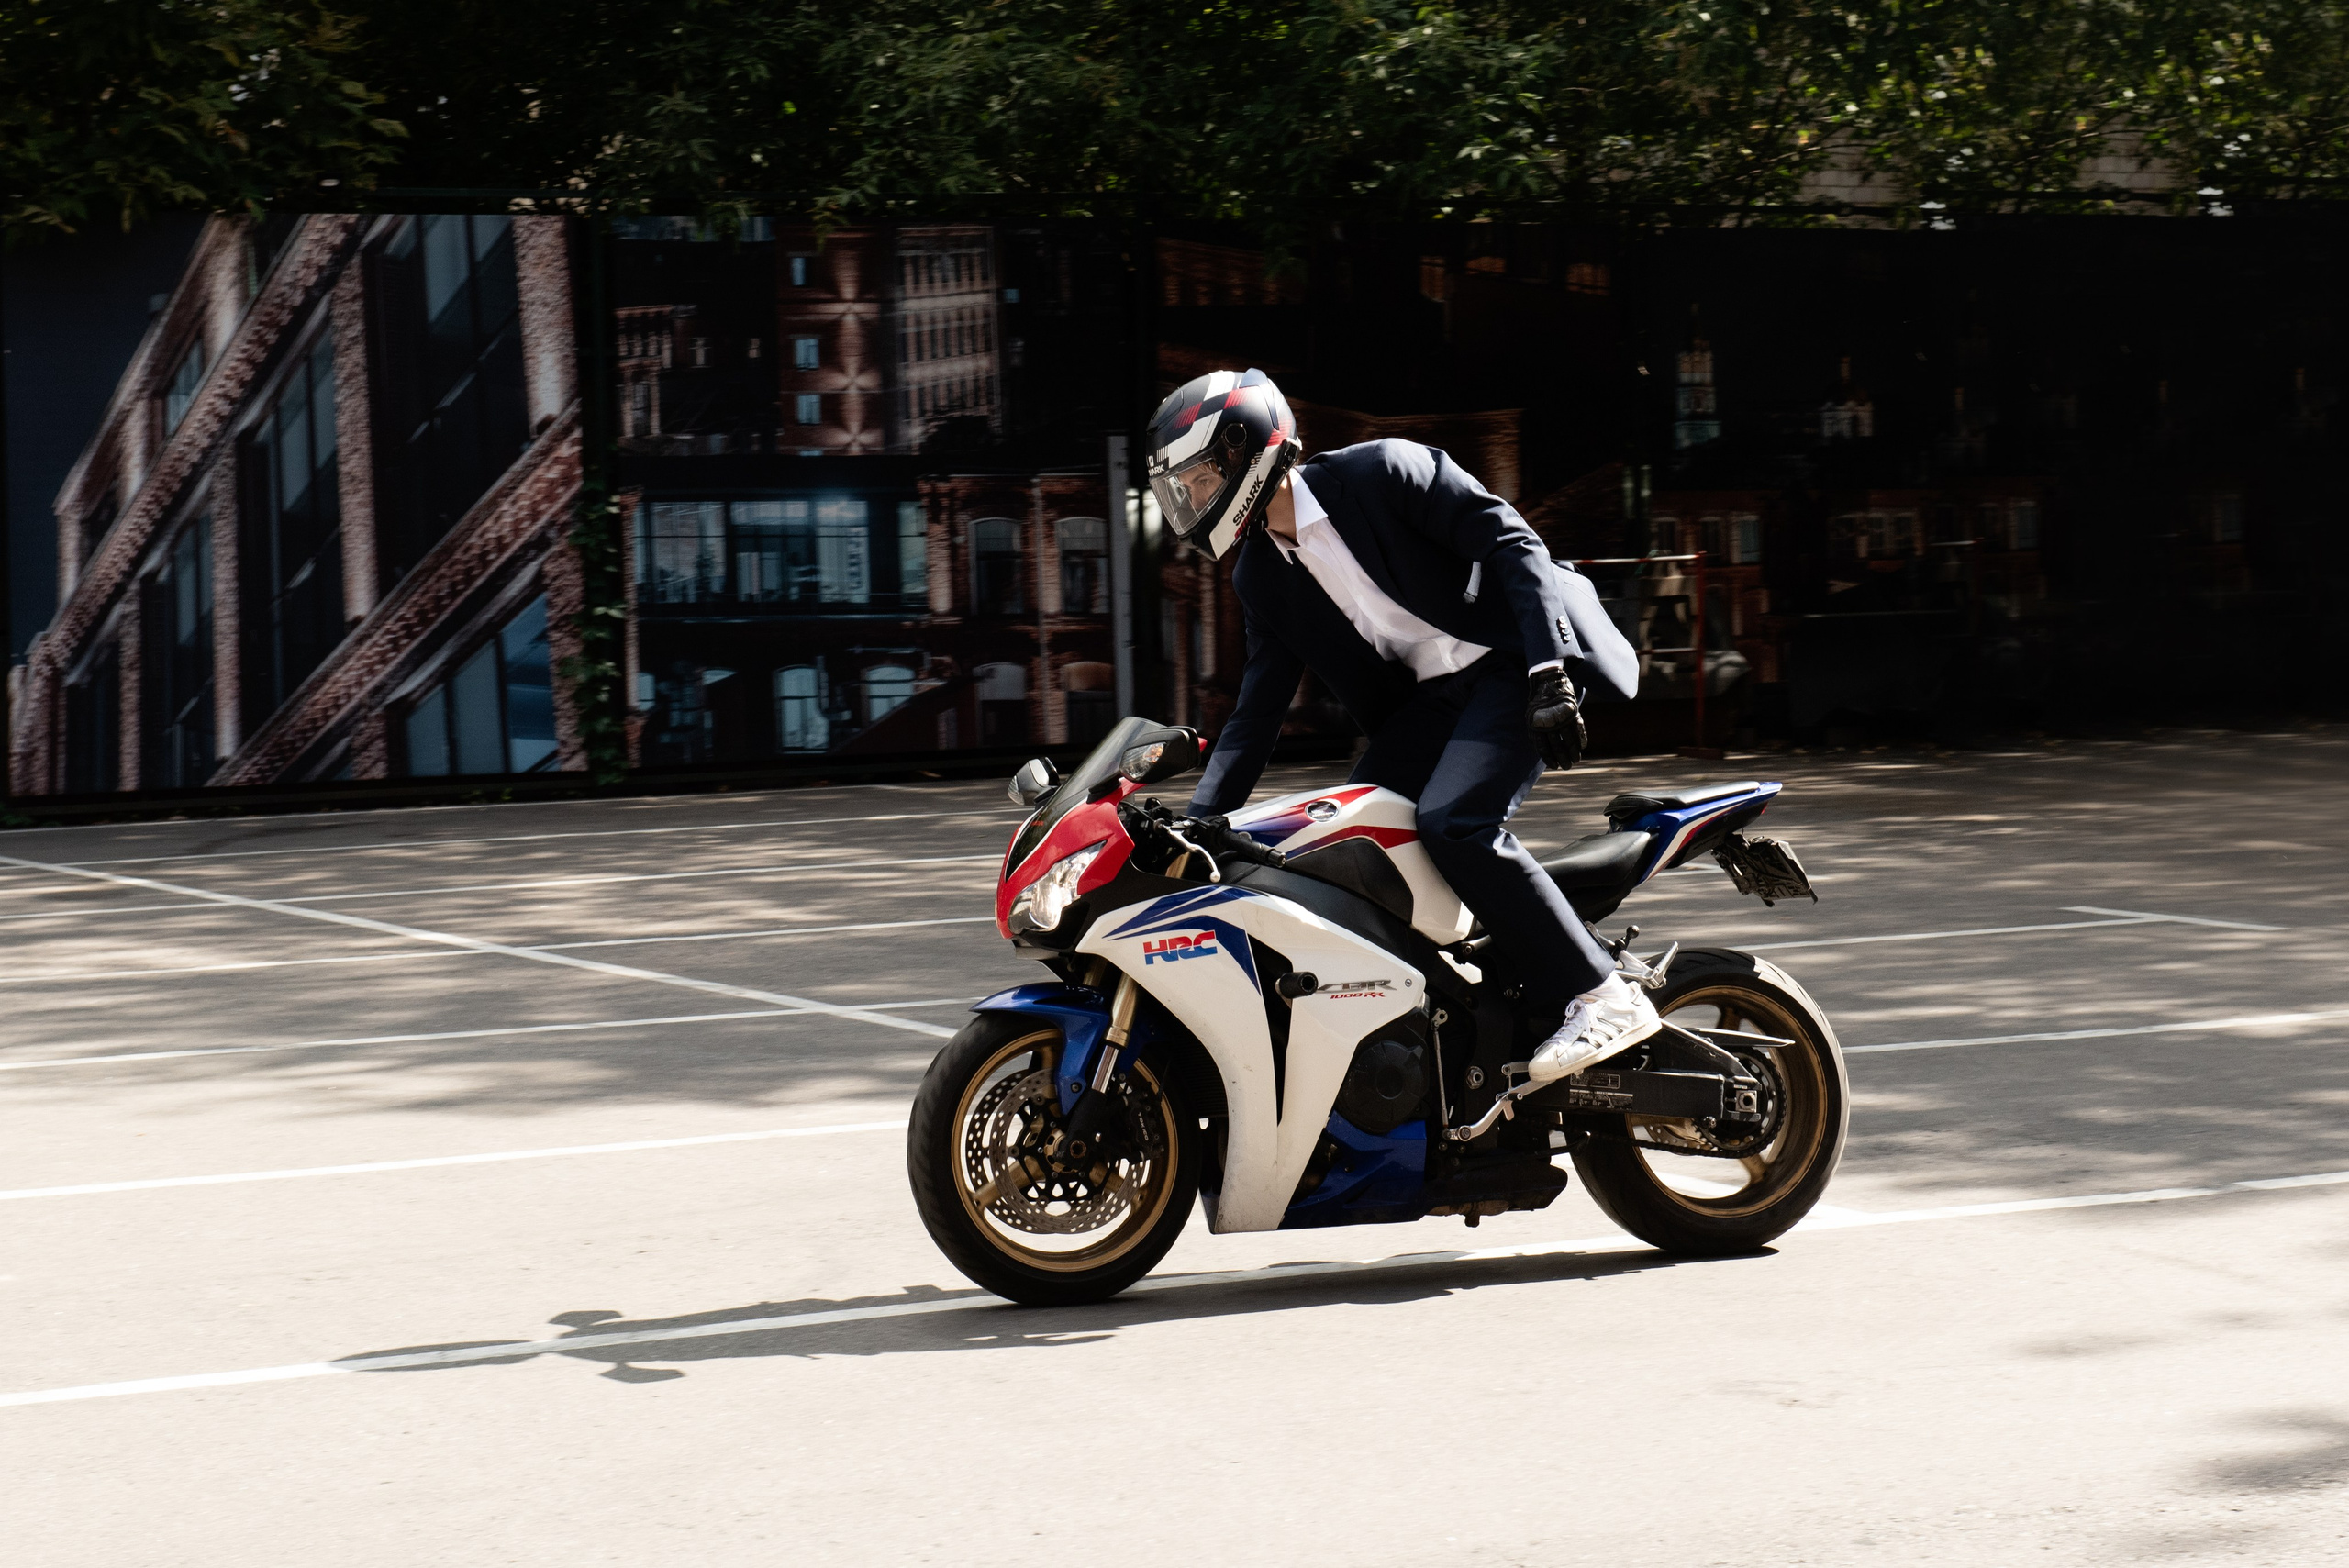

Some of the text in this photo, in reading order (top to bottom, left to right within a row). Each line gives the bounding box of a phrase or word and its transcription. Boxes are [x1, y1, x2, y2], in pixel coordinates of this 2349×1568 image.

[1148, 463, 1165, 477] HARK
[1232, 473, 1264, 526] SHARK
[1142, 930, 1218, 965] HRC
[1138, 1111, 1149, 1141] TOKICO
